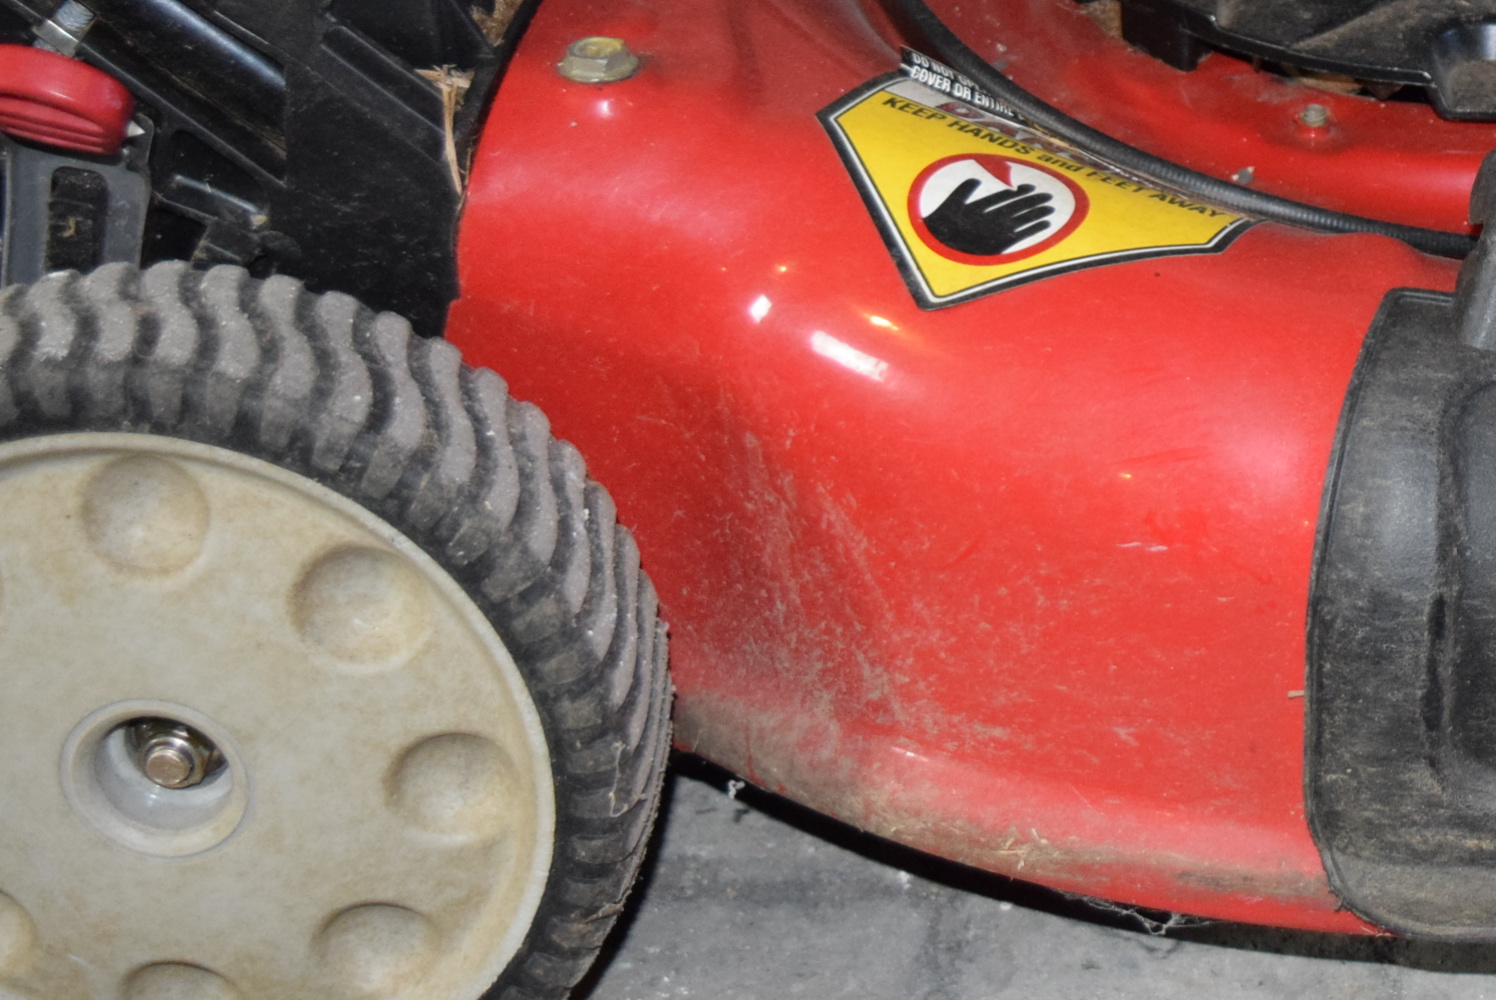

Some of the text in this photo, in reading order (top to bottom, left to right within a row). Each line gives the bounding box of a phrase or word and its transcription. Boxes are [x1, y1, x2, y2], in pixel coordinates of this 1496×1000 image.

[910, 66, 951, 92] COVER
[954, 83, 972, 100] OR
[911, 53, 955, 79] DO NOT
[881, 96, 1227, 217] KEEP HANDS and FEET AWAY
